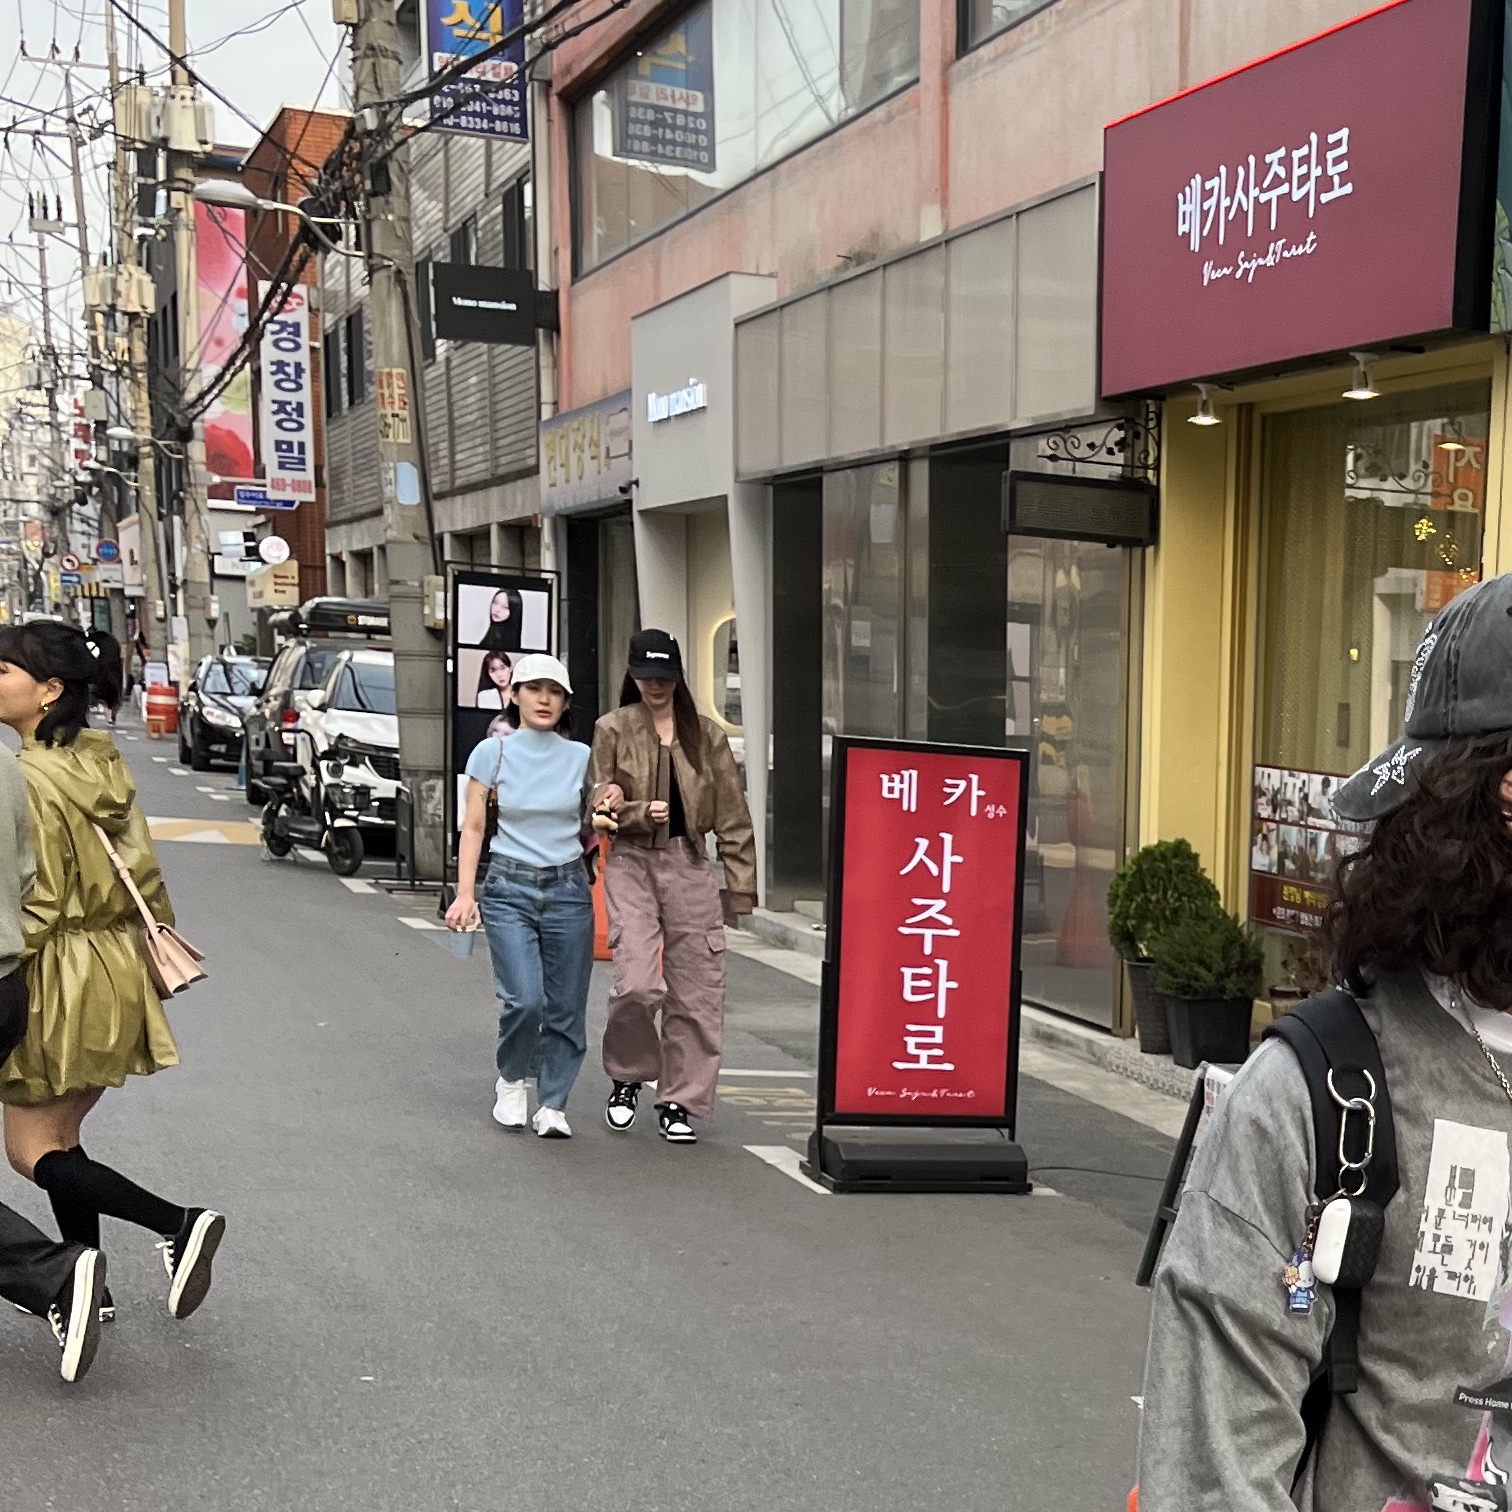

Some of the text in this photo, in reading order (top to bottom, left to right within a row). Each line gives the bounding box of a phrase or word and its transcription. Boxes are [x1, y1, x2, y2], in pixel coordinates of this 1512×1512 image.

[1177, 126, 1354, 252] 베카사주타로
[268, 319, 308, 472] 경창정밀
[1458, 1392, 1484, 1406] Press
[1485, 1397, 1509, 1409] Home
